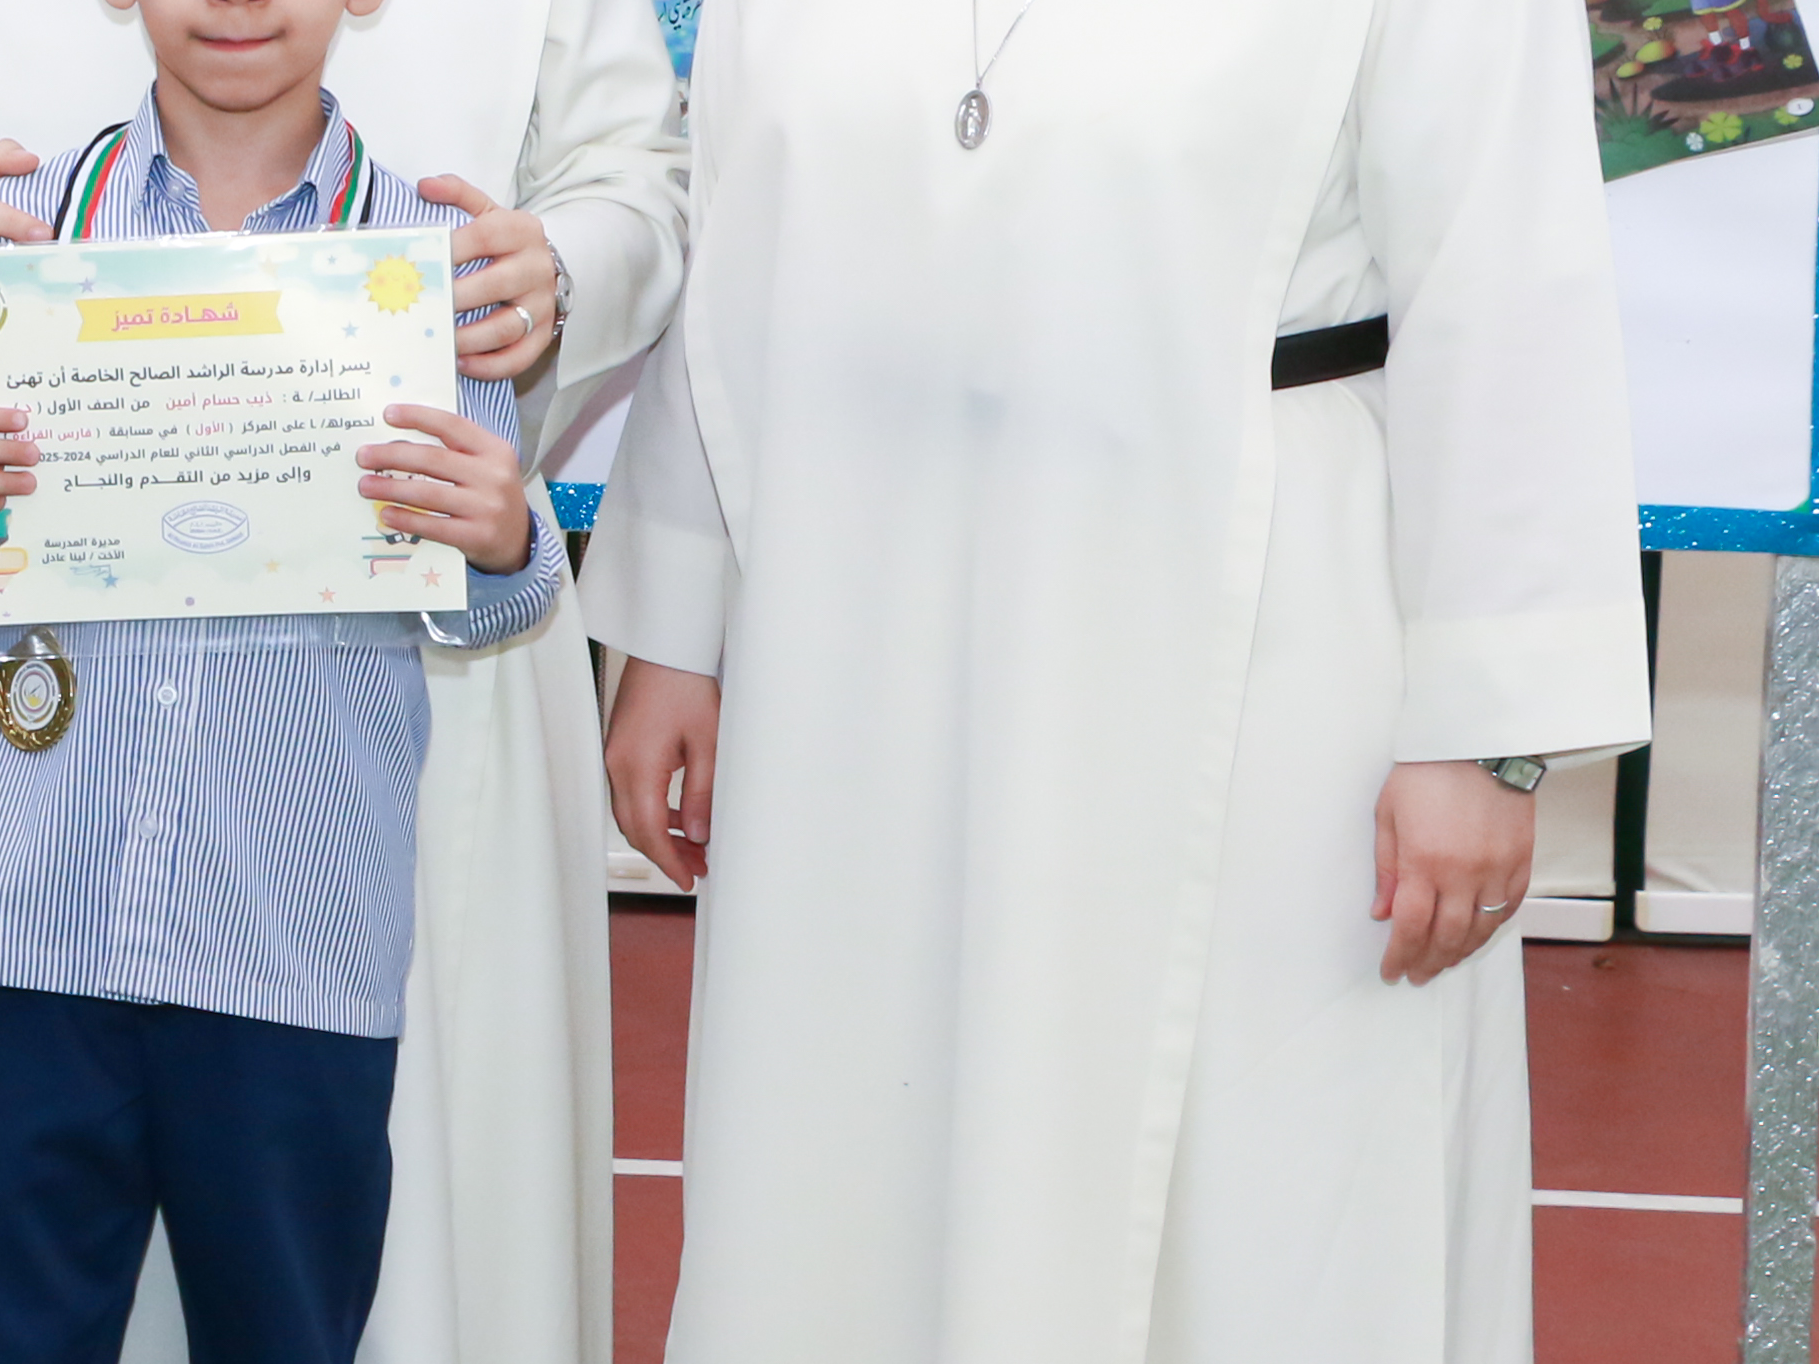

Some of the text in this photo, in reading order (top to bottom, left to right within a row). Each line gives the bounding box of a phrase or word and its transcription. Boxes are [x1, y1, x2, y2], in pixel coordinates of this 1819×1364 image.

[111, 302, 240, 332] شهادة تميز
[70, 367, 124, 385] الخاصة
[128, 365, 181, 387] الصالح
[185, 362, 236, 383] الراشد
[239, 360, 295, 379] مدرسة
[298, 358, 335, 378] إدارة
[338, 359, 372, 377] يسر
[47, 365, 67, 389] أن
[47, 397, 82, 416] الأول
[86, 397, 125, 411] الصف
[130, 399, 151, 413] من
[165, 392, 196, 411] أمين
[202, 393, 241, 410] حسام
[57, 427, 92, 442] فارس
[108, 425, 154, 438] مسابقة
[157, 427, 178, 440] في
[195, 421, 225, 437] الأول
[241, 420, 277, 436] المركز
[281, 421, 306, 434] على
[95, 449, 146, 464] الدراسي
[149, 447, 180, 462] للعام
[184, 446, 220, 463] الثاني
[223, 444, 275, 462] الدراسي
[278, 441, 317, 457] الفصل
[320, 441, 342, 458] في
[209, 469, 232, 486] من
[237, 468, 271, 486] مزيد
[275, 467, 312, 485] وإلى
[43, 537, 121, 550] مديرة المدرسة
[41, 552, 66, 565] عادل
[97, 550, 126, 562] الأخت
